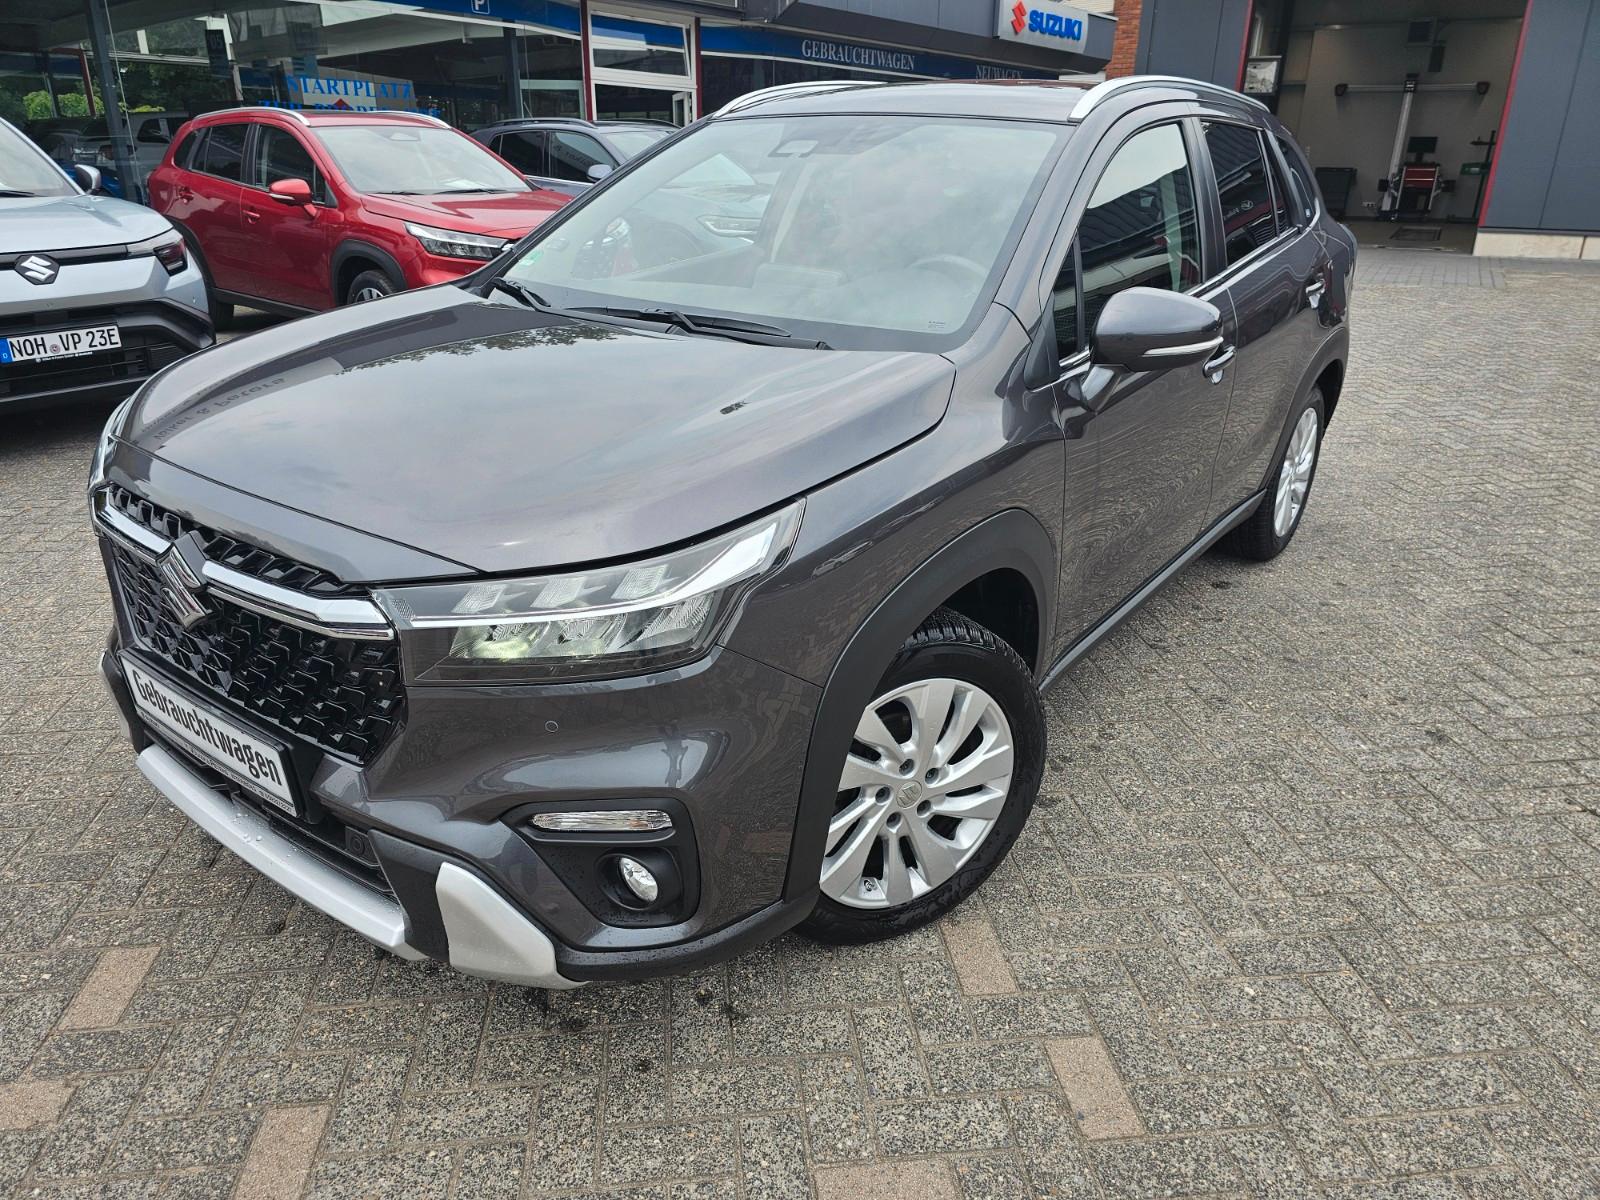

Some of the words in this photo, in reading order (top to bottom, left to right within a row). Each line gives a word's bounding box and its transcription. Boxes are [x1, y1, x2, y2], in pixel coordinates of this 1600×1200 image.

[1028, 10, 1082, 41] SUZUKI
[801, 39, 915, 70] GEBRAUCHTWAGEN
[287, 75, 412, 98] STARTPLATZ
[9, 337, 47, 358] NOH
[59, 333, 81, 351] VP
[86, 328, 119, 348] 23E
[132, 669, 282, 786] Gebrauchtwagen
